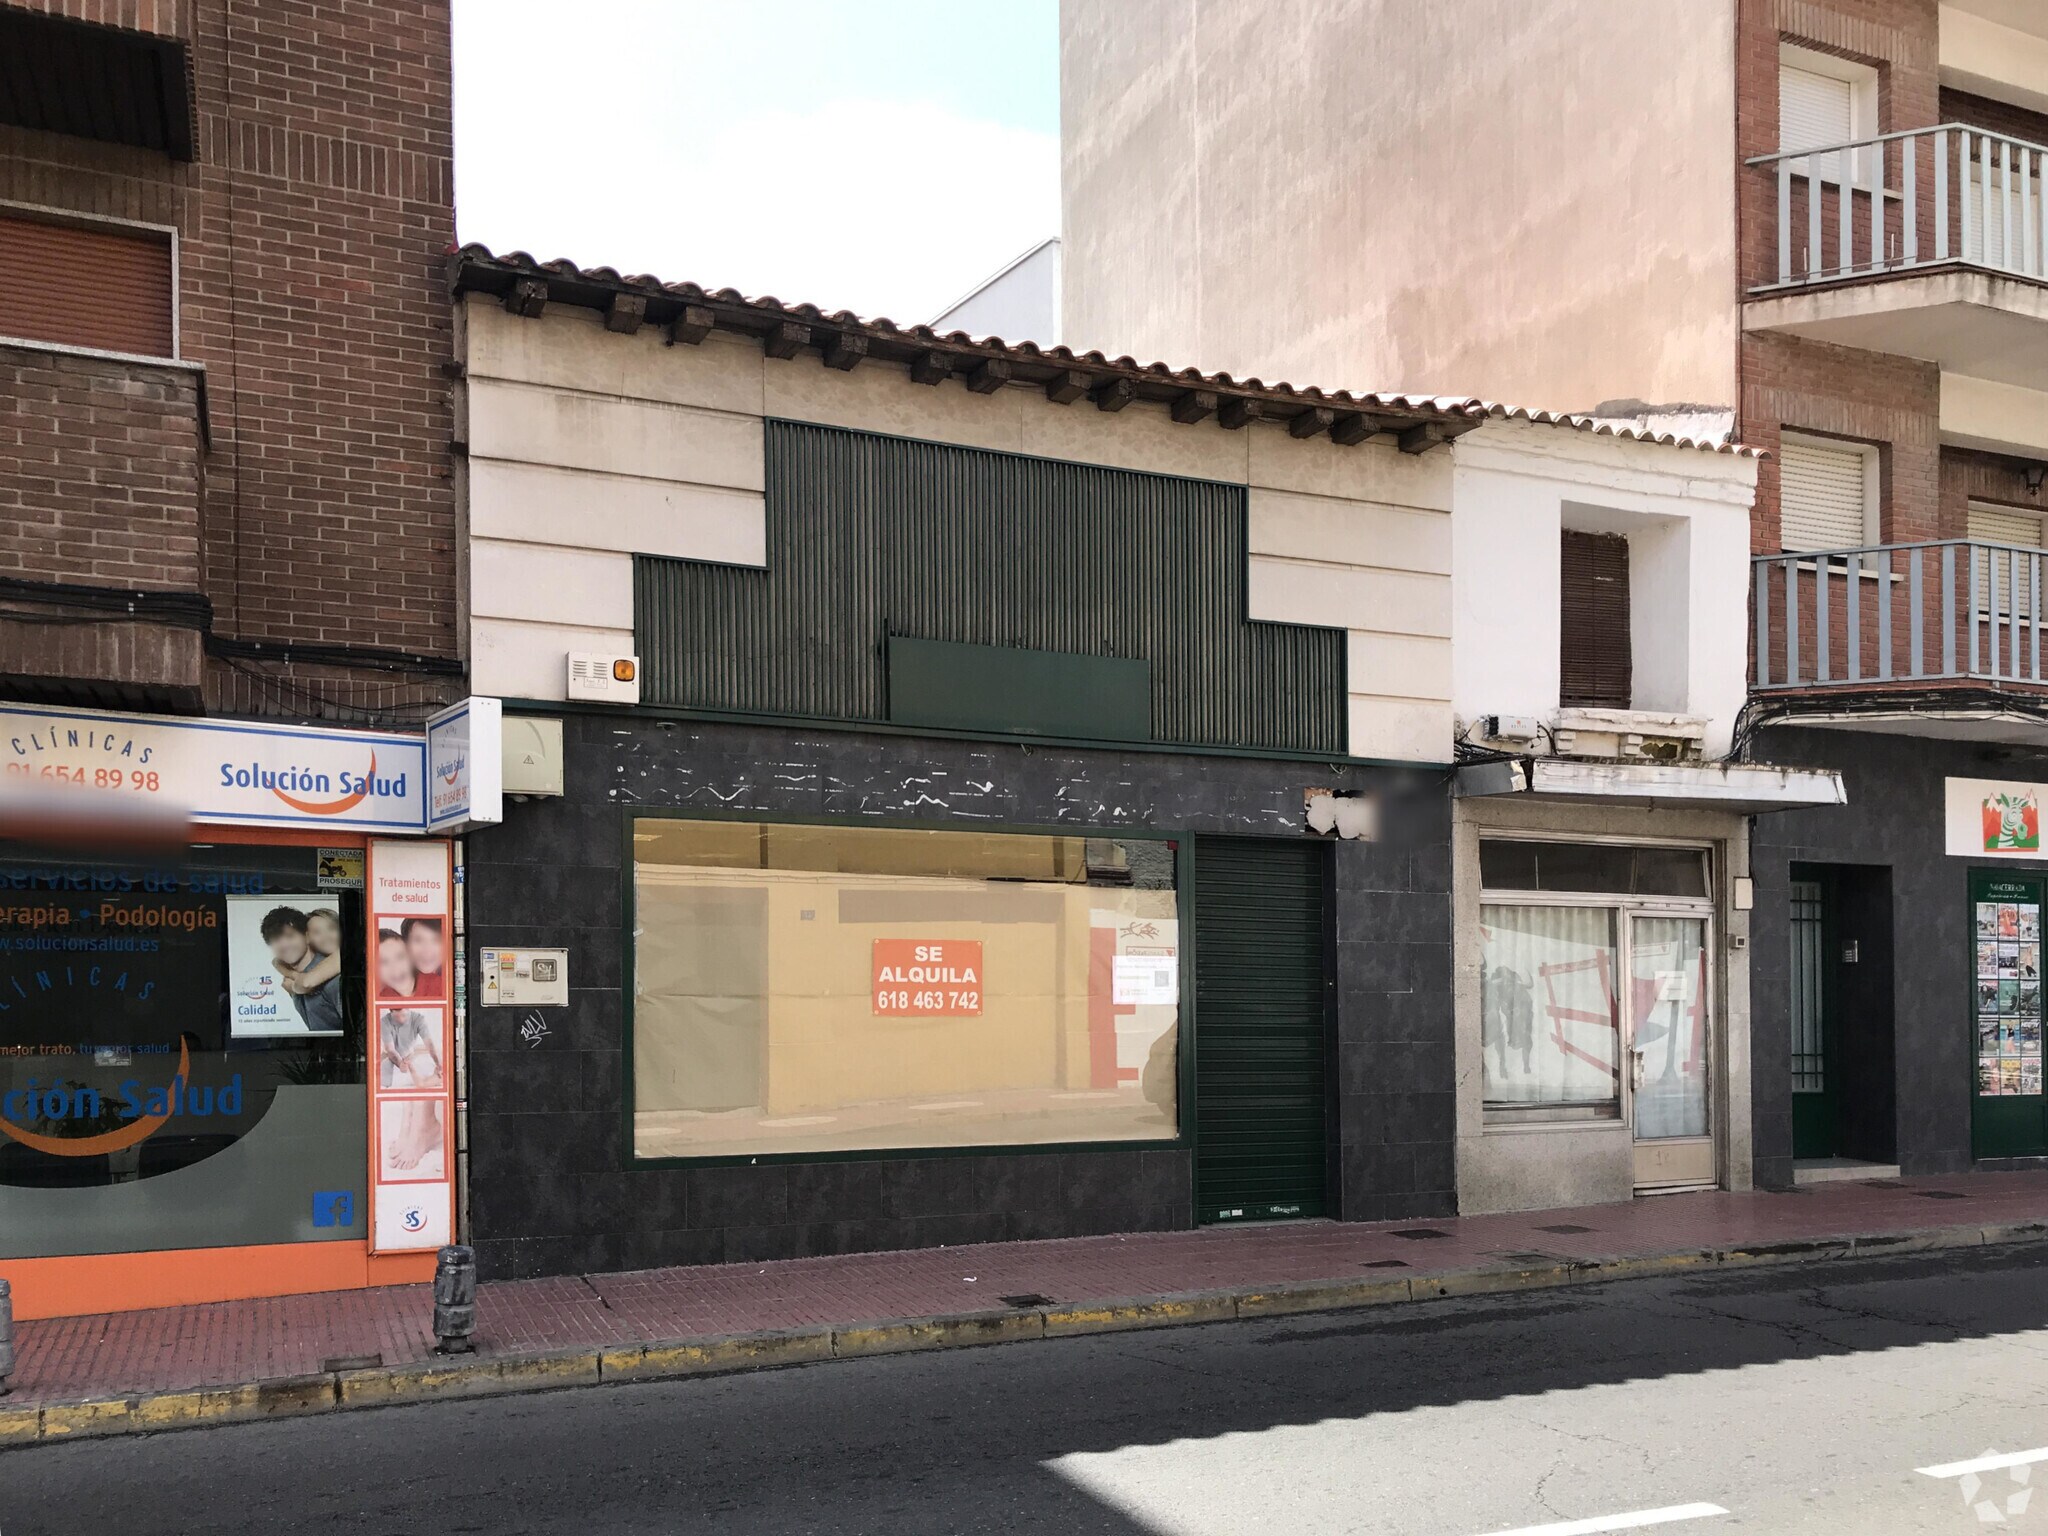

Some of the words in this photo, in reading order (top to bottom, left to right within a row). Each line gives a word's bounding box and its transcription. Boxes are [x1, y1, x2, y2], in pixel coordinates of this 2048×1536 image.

[12, 725, 153, 764] CLÍNICAS
[94, 767, 123, 789] 89
[131, 770, 160, 792] 98
[220, 762, 330, 793] Solución
[339, 771, 406, 798] Salud
[319, 849, 363, 857] CONECTADA
[143, 870, 177, 893] de
[188, 869, 264, 895] salud
[379, 877, 441, 890] Tratamientos
[391, 892, 403, 903] de
[405, 893, 428, 903] salud
[100, 904, 217, 931] Podología
[914, 945, 943, 962] SE
[879, 966, 977, 984] ALQUILA
[878, 990, 908, 1009] 618
[913, 991, 944, 1009] 463
[949, 991, 978, 1009] 742
[238, 1004, 276, 1015] Calidad
[137, 1043, 170, 1054] salud
[118, 1073, 243, 1117] Salud
